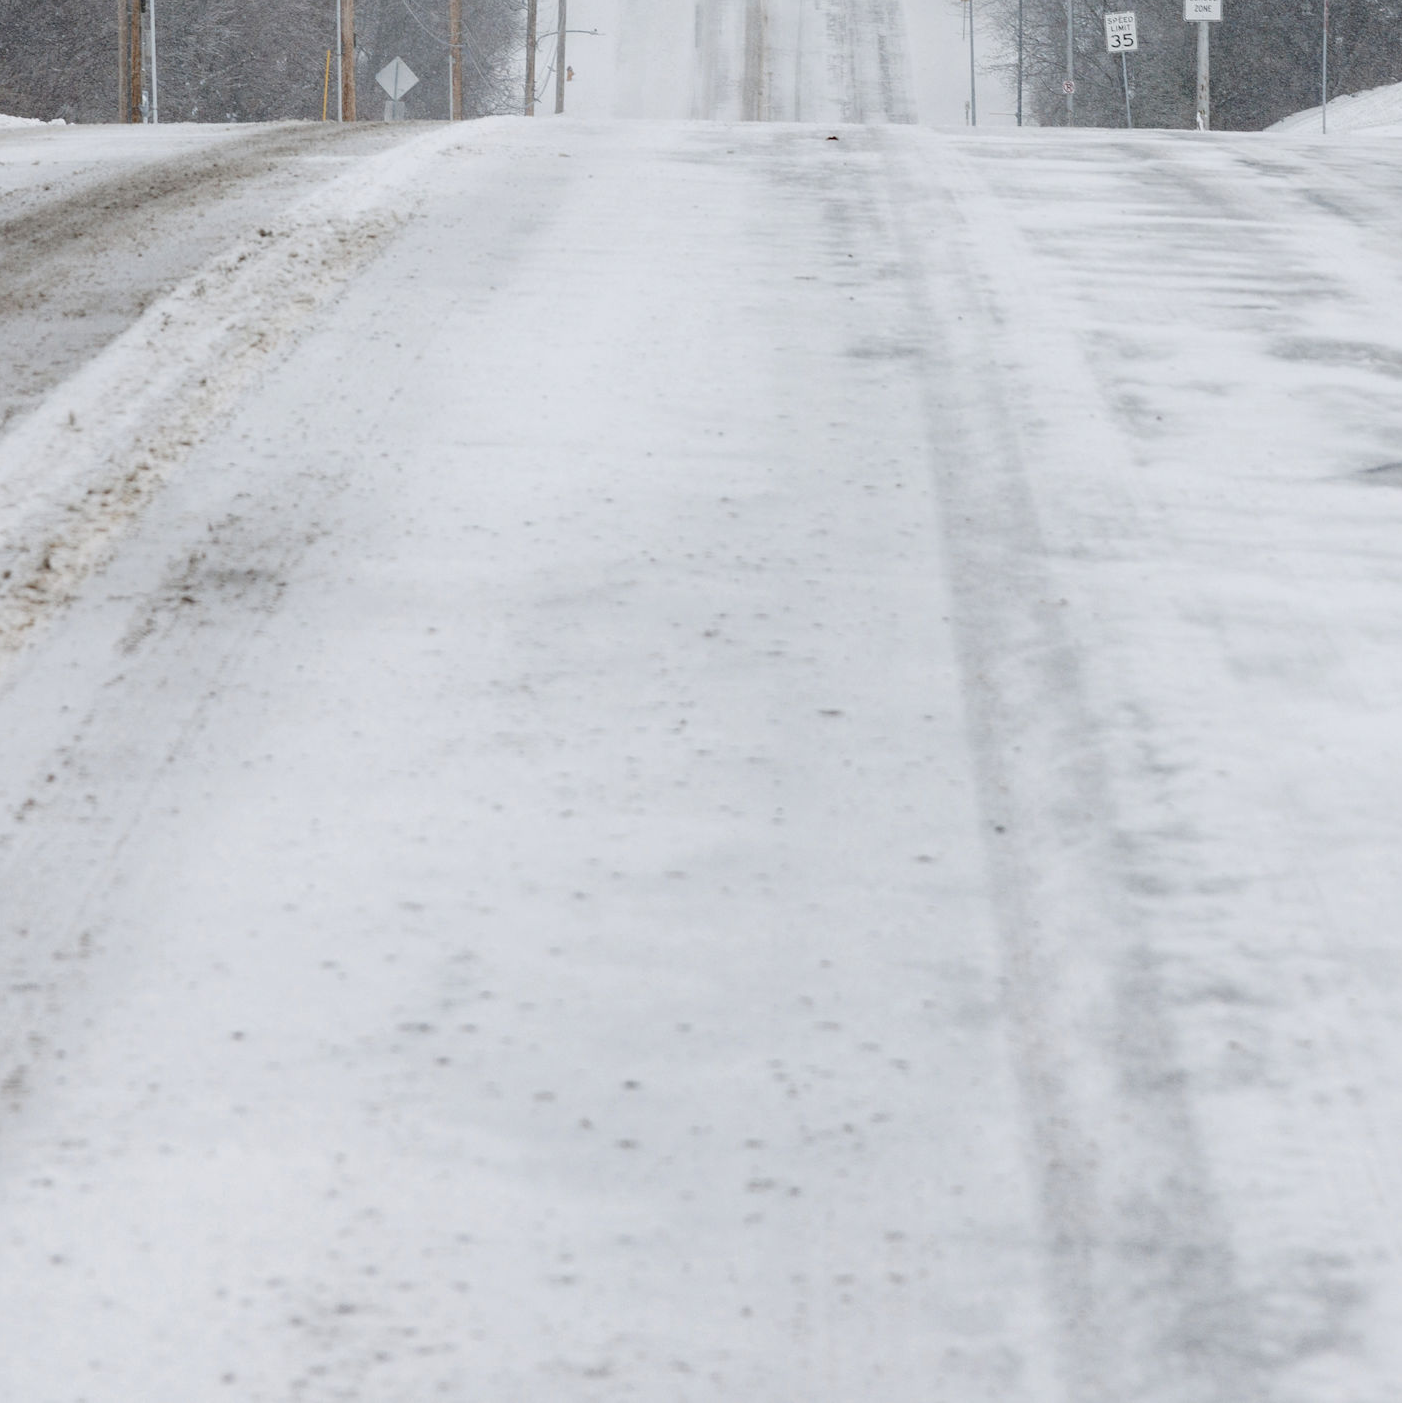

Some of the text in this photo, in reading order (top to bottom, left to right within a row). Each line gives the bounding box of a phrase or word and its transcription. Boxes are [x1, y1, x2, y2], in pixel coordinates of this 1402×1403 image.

[1194, 4, 1212, 13] ZONE
[1107, 16, 1134, 24] SPEED
[1110, 24, 1131, 32] LIMIT
[1110, 33, 1134, 48] 35
